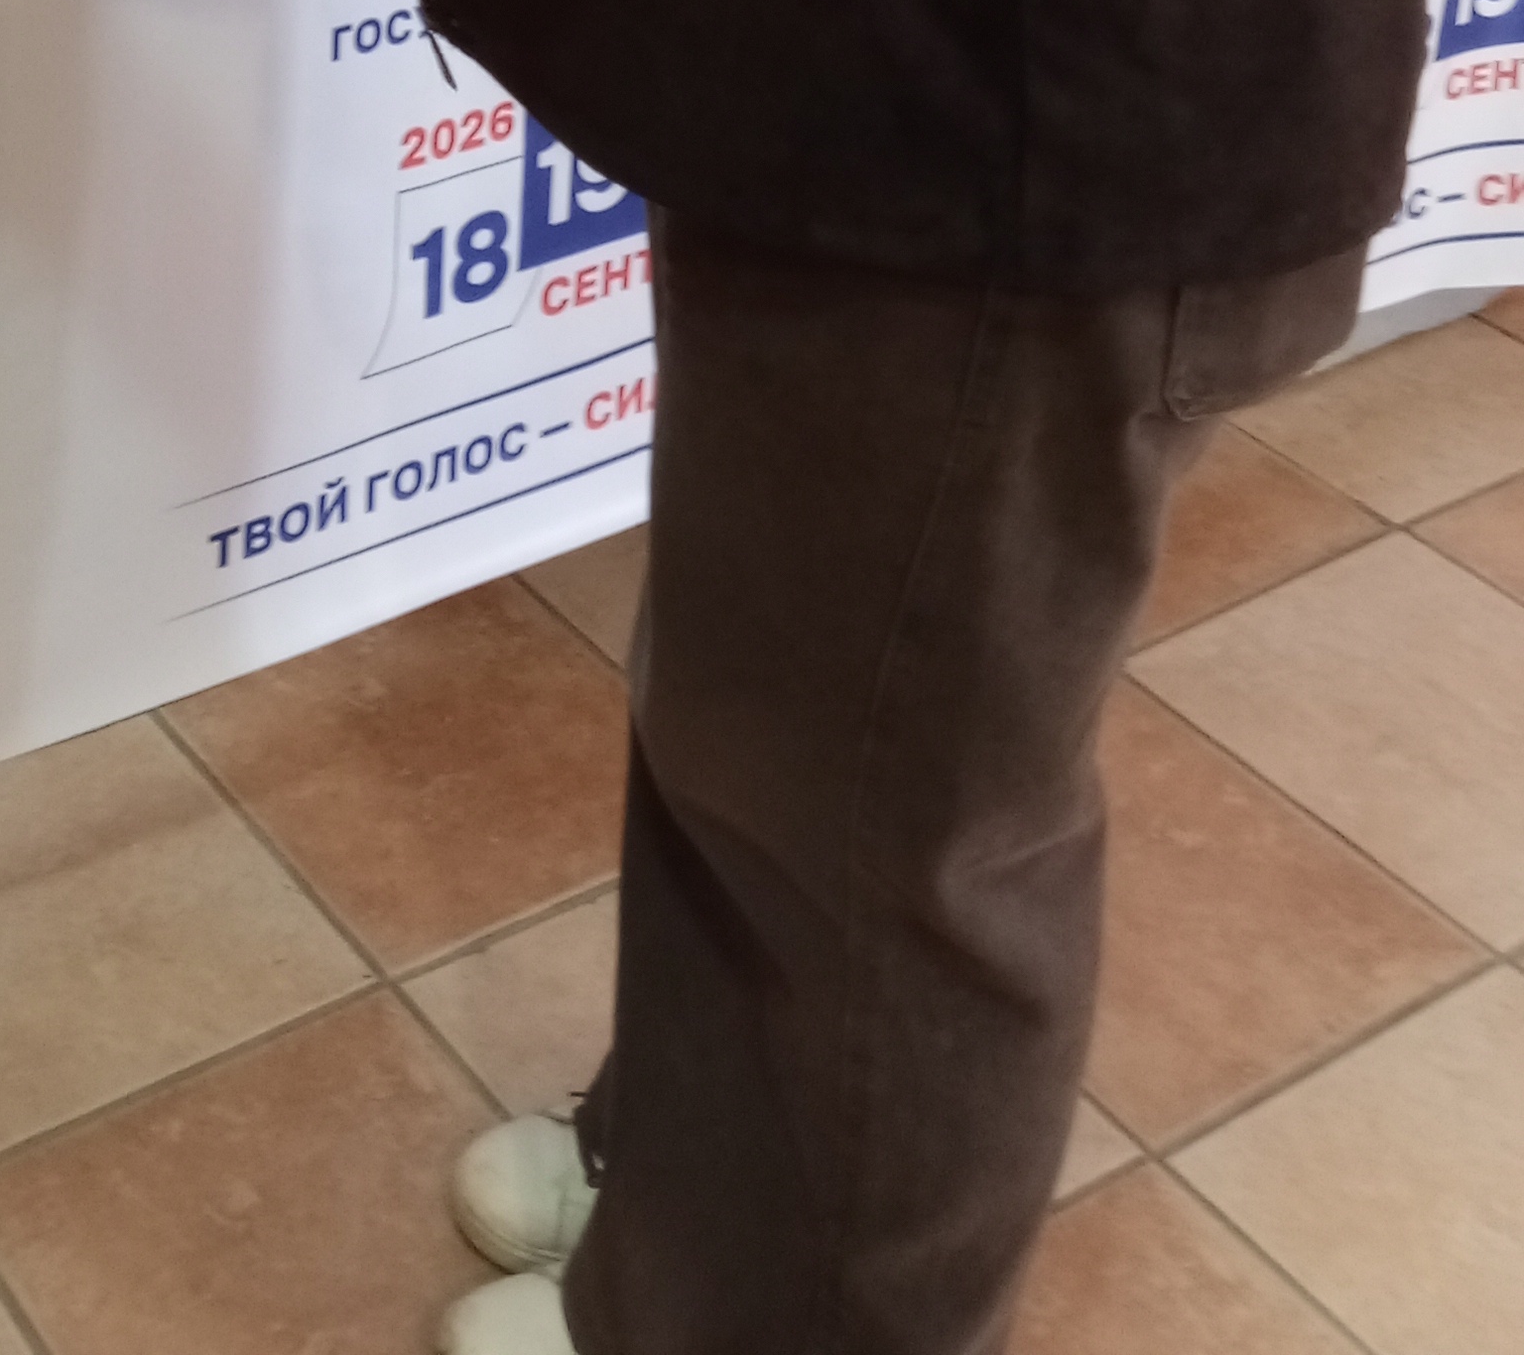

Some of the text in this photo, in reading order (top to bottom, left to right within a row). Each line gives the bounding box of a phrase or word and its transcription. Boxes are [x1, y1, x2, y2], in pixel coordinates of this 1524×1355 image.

[399, 100, 516, 171] 2026
[410, 209, 510, 320] 18
[209, 475, 350, 569] ТВОЙ
[364, 422, 528, 514] ГОЛОС
